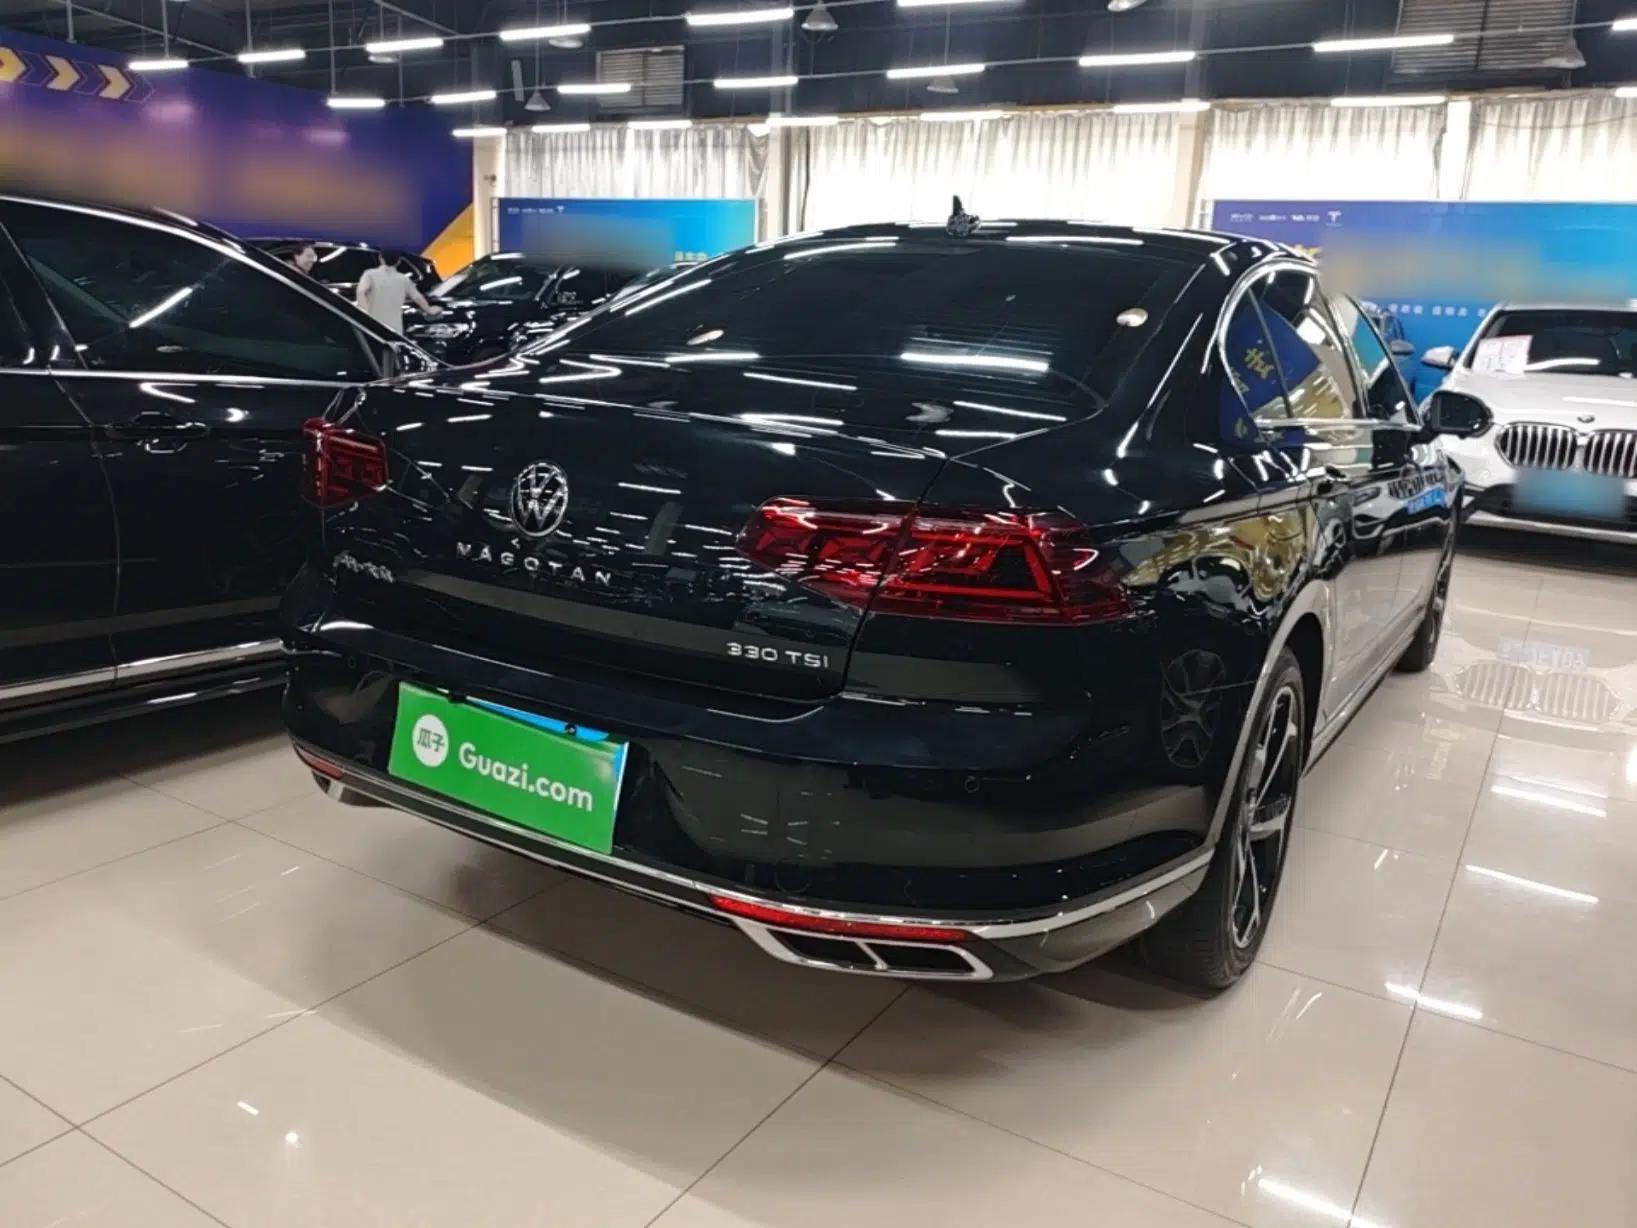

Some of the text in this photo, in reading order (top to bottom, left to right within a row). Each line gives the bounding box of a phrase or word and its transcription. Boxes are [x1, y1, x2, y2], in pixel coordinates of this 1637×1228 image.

[456, 541, 611, 586] MAGOTAN
[726, 642, 828, 669] 330 TSI
[416, 727, 446, 754] 瓜子
[458, 741, 593, 812] Guazi.com
